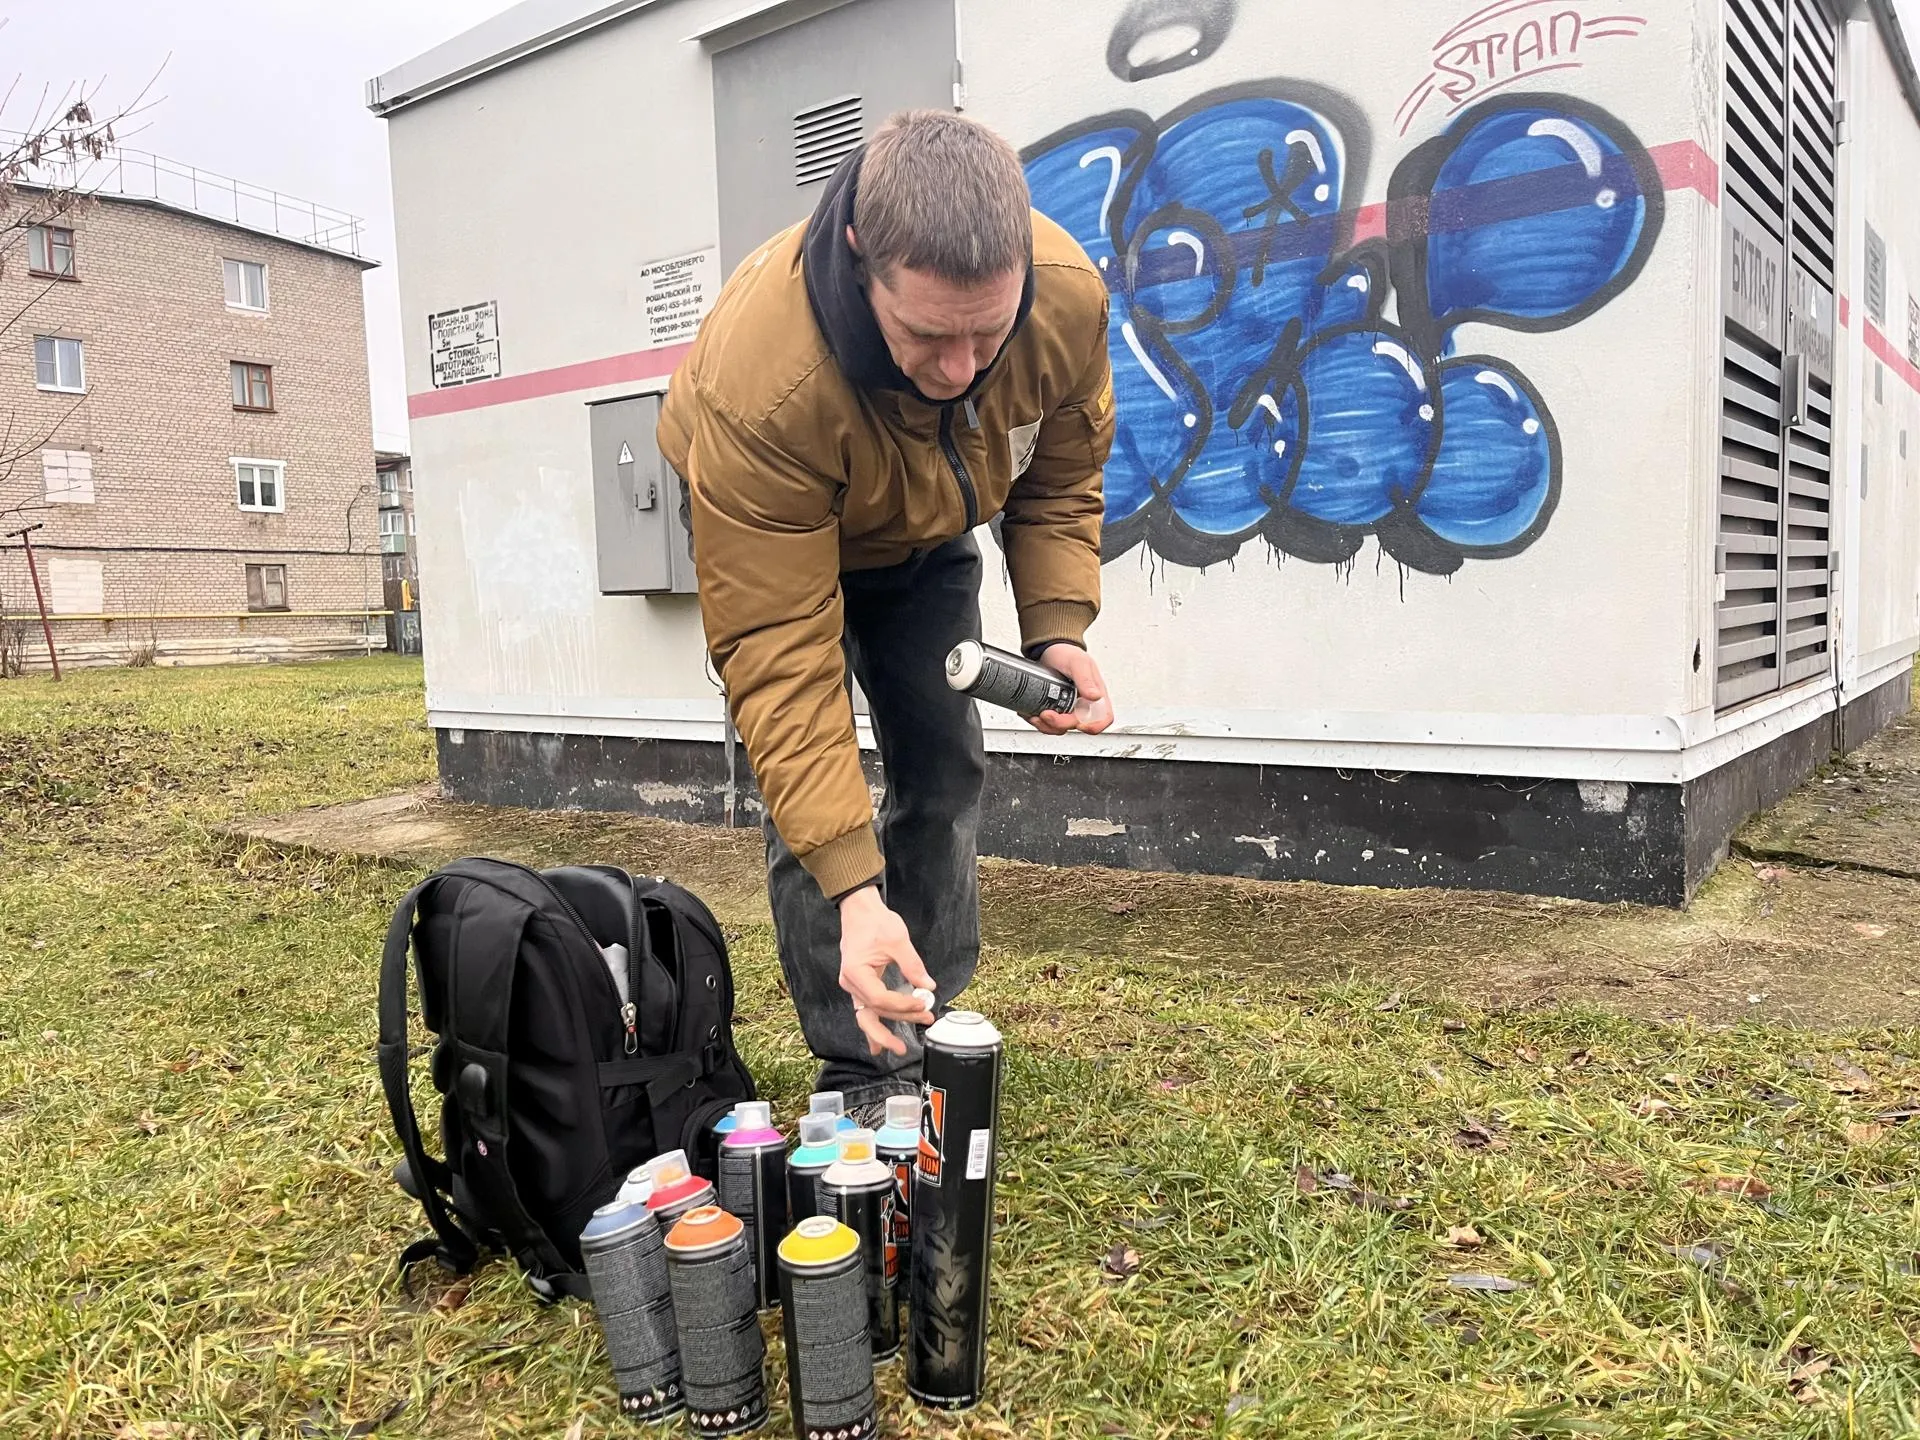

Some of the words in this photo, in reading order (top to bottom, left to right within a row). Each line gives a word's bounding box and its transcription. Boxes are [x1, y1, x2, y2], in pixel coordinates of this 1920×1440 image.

[640, 269, 650, 278] АО
[651, 255, 705, 275] МОСОБЛЭНЕРГО
[646, 285, 690, 303] РОШАЛЬСКИЙ
[692, 284, 702, 293] ПУ
[432, 314, 470, 331] ОХРАННАЯ
[475, 309, 494, 321] ЗОНА
[650, 312, 677, 325] Горячая
[437, 321, 484, 339] ПОДСТАНЦИИ
[435, 352, 498, 373] АВТОТРАНСПОРТА
[448, 346, 481, 361] СТОЯНКА
[442, 365, 486, 381] ЗАПРЕЩЕНА
